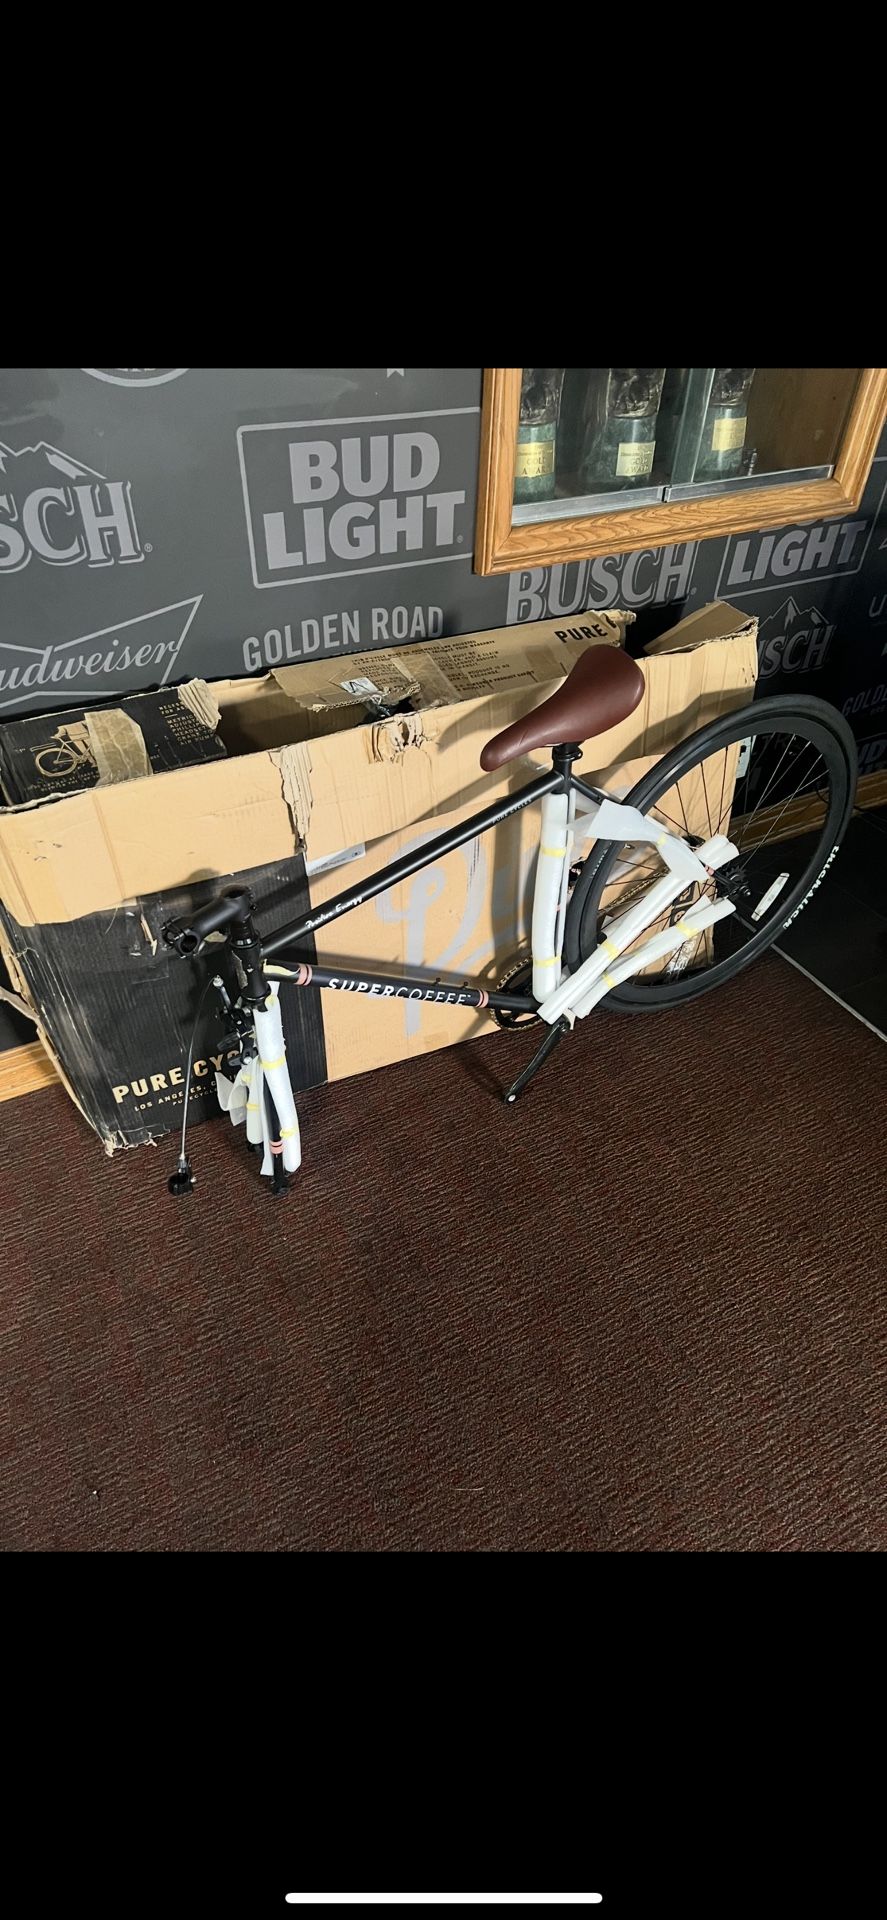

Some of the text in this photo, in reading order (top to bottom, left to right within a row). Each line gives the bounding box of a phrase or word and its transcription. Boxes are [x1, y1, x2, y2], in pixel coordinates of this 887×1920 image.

[289, 431, 441, 504] BUD
[263, 490, 466, 570] LIGHT
[726, 519, 868, 587] LIGHT
[506, 540, 701, 625] BUSCH
[242, 605, 444, 673] GOLDEN ROAD
[554, 623, 608, 644] PURE
[758, 623, 839, 681] SCH
[112, 1067, 185, 1104] PURE
[134, 1101, 153, 1112] LOS
